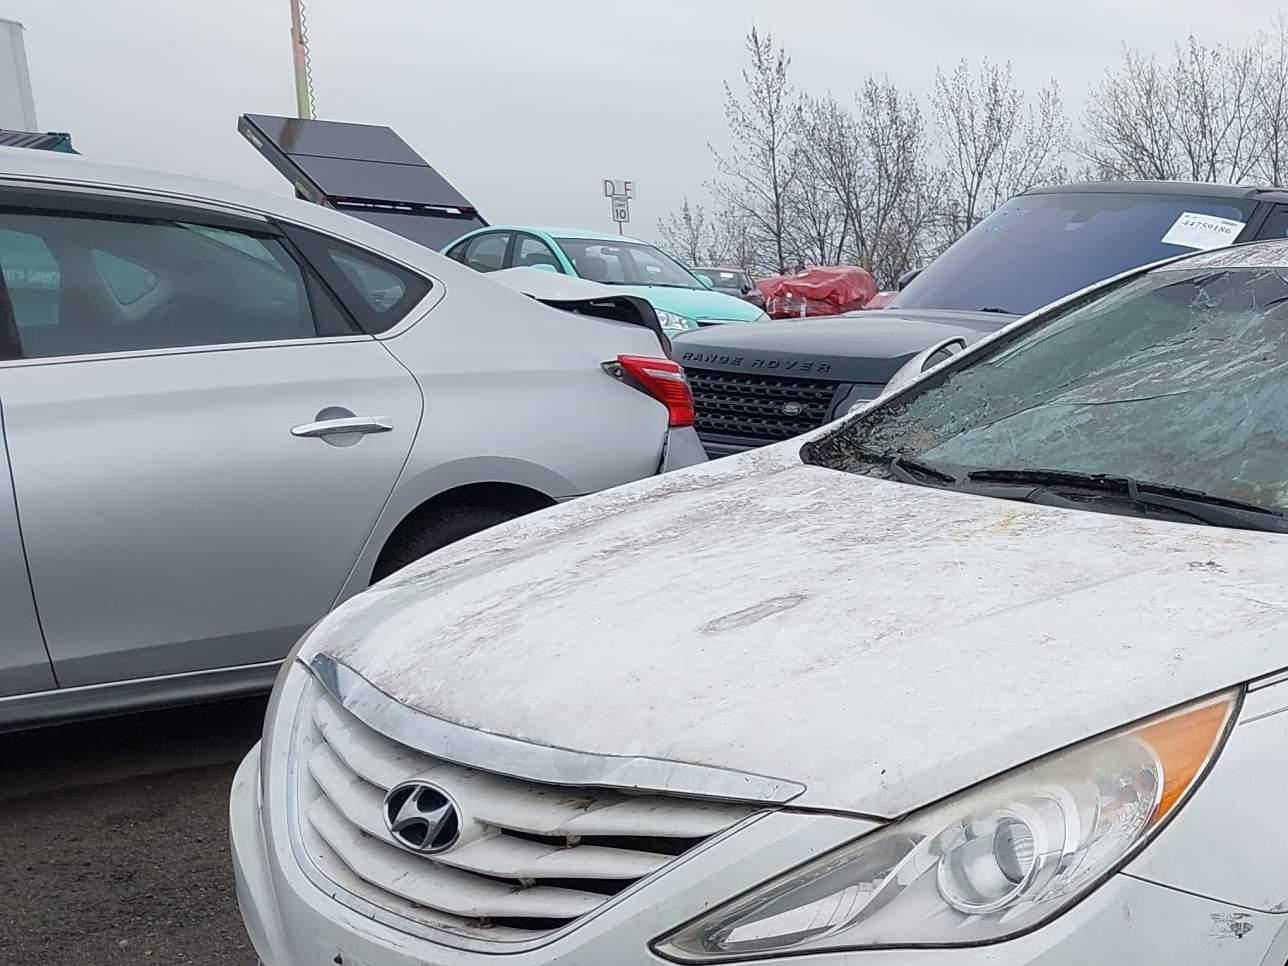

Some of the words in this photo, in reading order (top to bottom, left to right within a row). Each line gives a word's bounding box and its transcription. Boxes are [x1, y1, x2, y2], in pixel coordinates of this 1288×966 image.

[615, 209, 626, 219] 10
[682, 351, 744, 366] RANGE
[751, 359, 832, 373] ROVER
